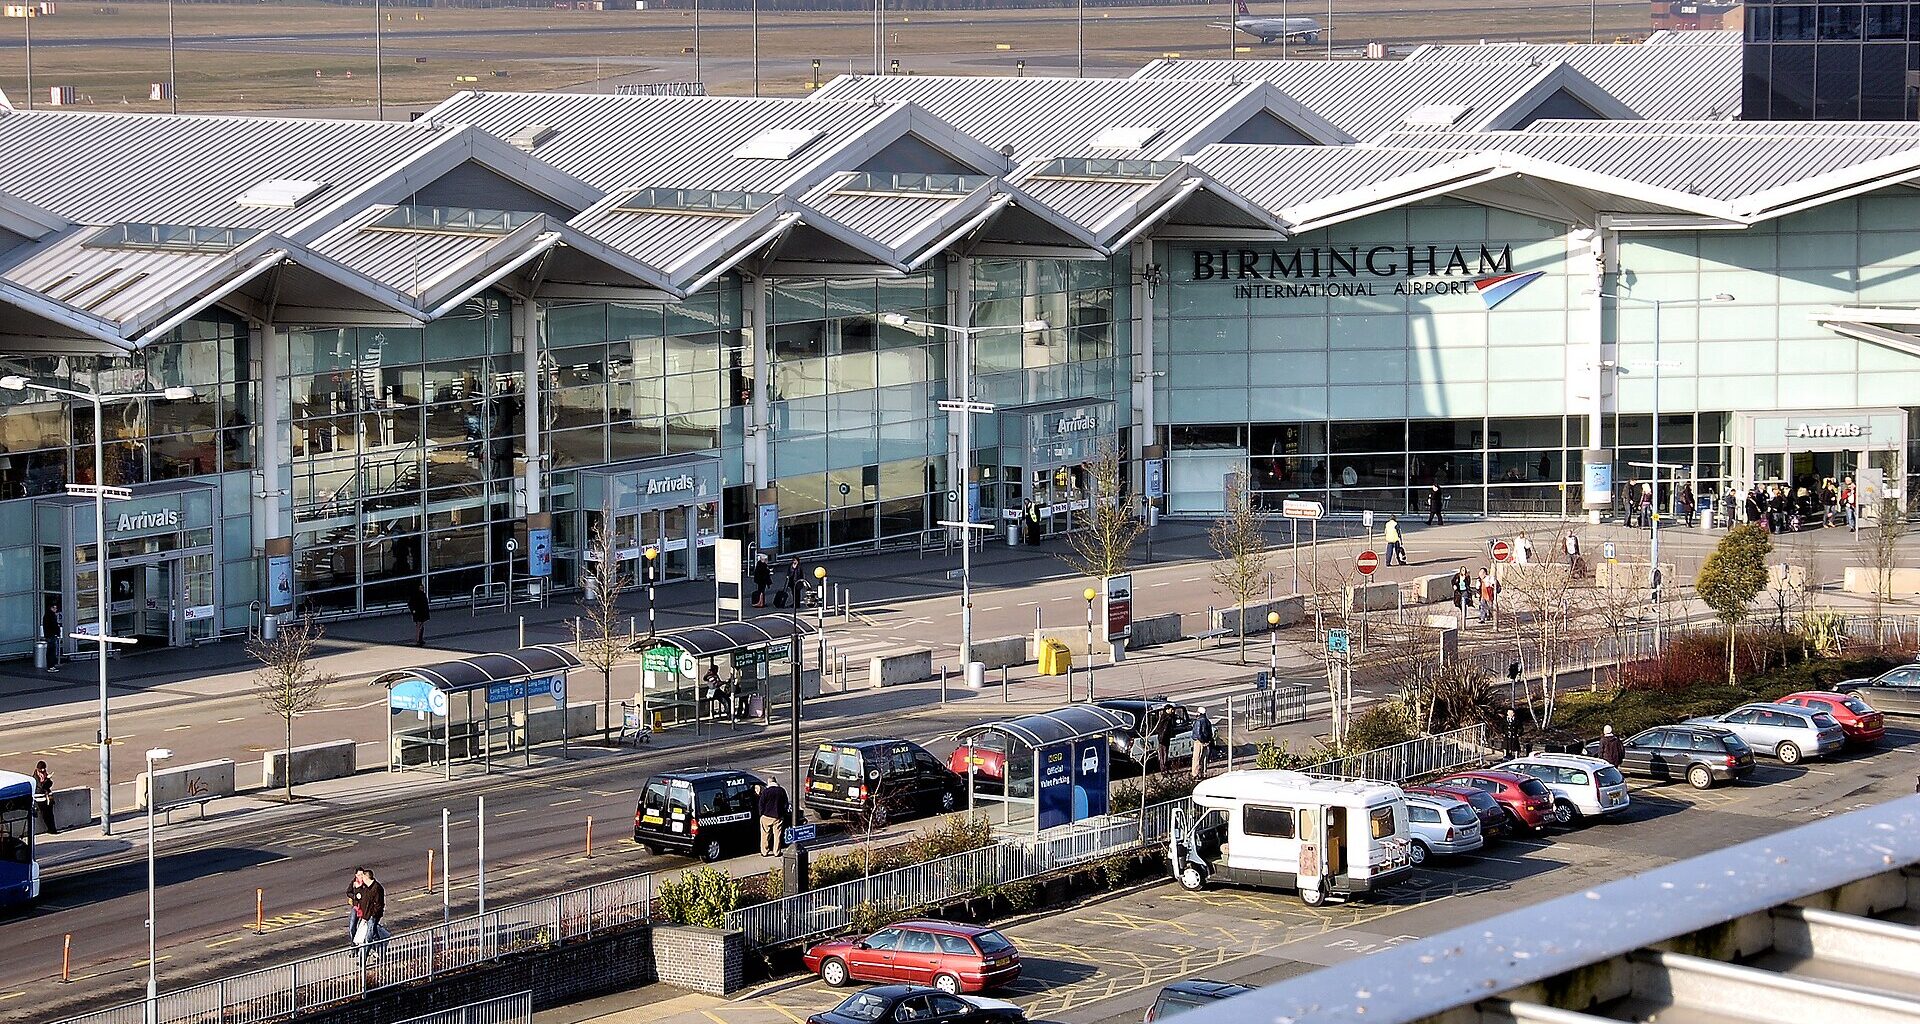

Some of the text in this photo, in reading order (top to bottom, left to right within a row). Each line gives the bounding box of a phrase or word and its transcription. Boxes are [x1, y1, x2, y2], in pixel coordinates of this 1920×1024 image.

[1193, 242, 1514, 281] BIRMINGHAM
[1235, 280, 1470, 300] INTERNATIONAL AIRPORT
[1058, 416, 1096, 433] Arrivals
[1797, 422, 1861, 438] Arrivals
[647, 474, 694, 495] Arrivals
[117, 508, 178, 532] Arrivals
[685, 659, 692, 670] D
[554, 680, 562, 693] C
[434, 694, 443, 707] C
[892, 746, 909, 754] TAXI
[1047, 765, 1063, 775] Official
[726, 778, 745, 787] TAXI
[1053, 776, 1070, 786] Parking
